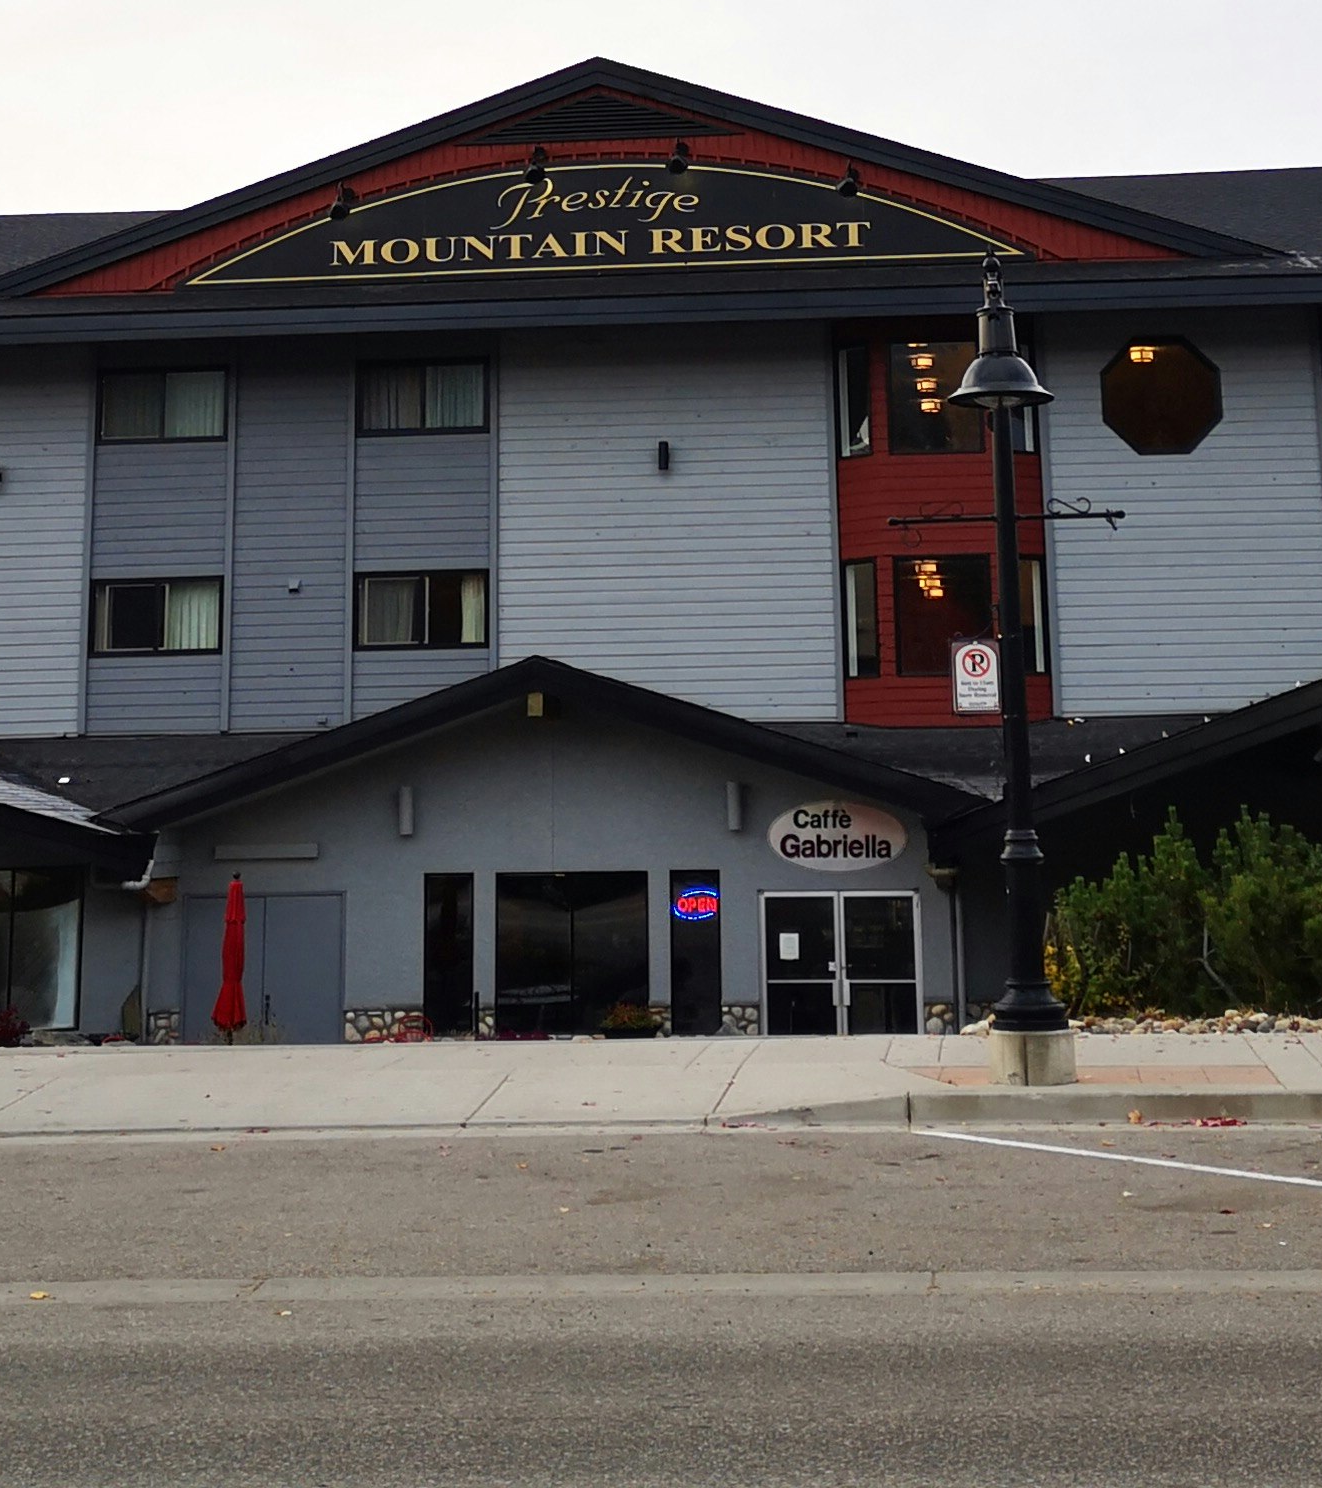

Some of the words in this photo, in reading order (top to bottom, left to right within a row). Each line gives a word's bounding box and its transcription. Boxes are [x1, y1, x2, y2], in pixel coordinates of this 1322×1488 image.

[490, 176, 699, 230] Prestige
[329, 230, 629, 266] MOUNTAIN
[648, 221, 871, 254] RESORT
[793, 809, 852, 829] Caffè
[780, 833, 892, 859] Gabriella
[678, 896, 717, 913] OPEN
